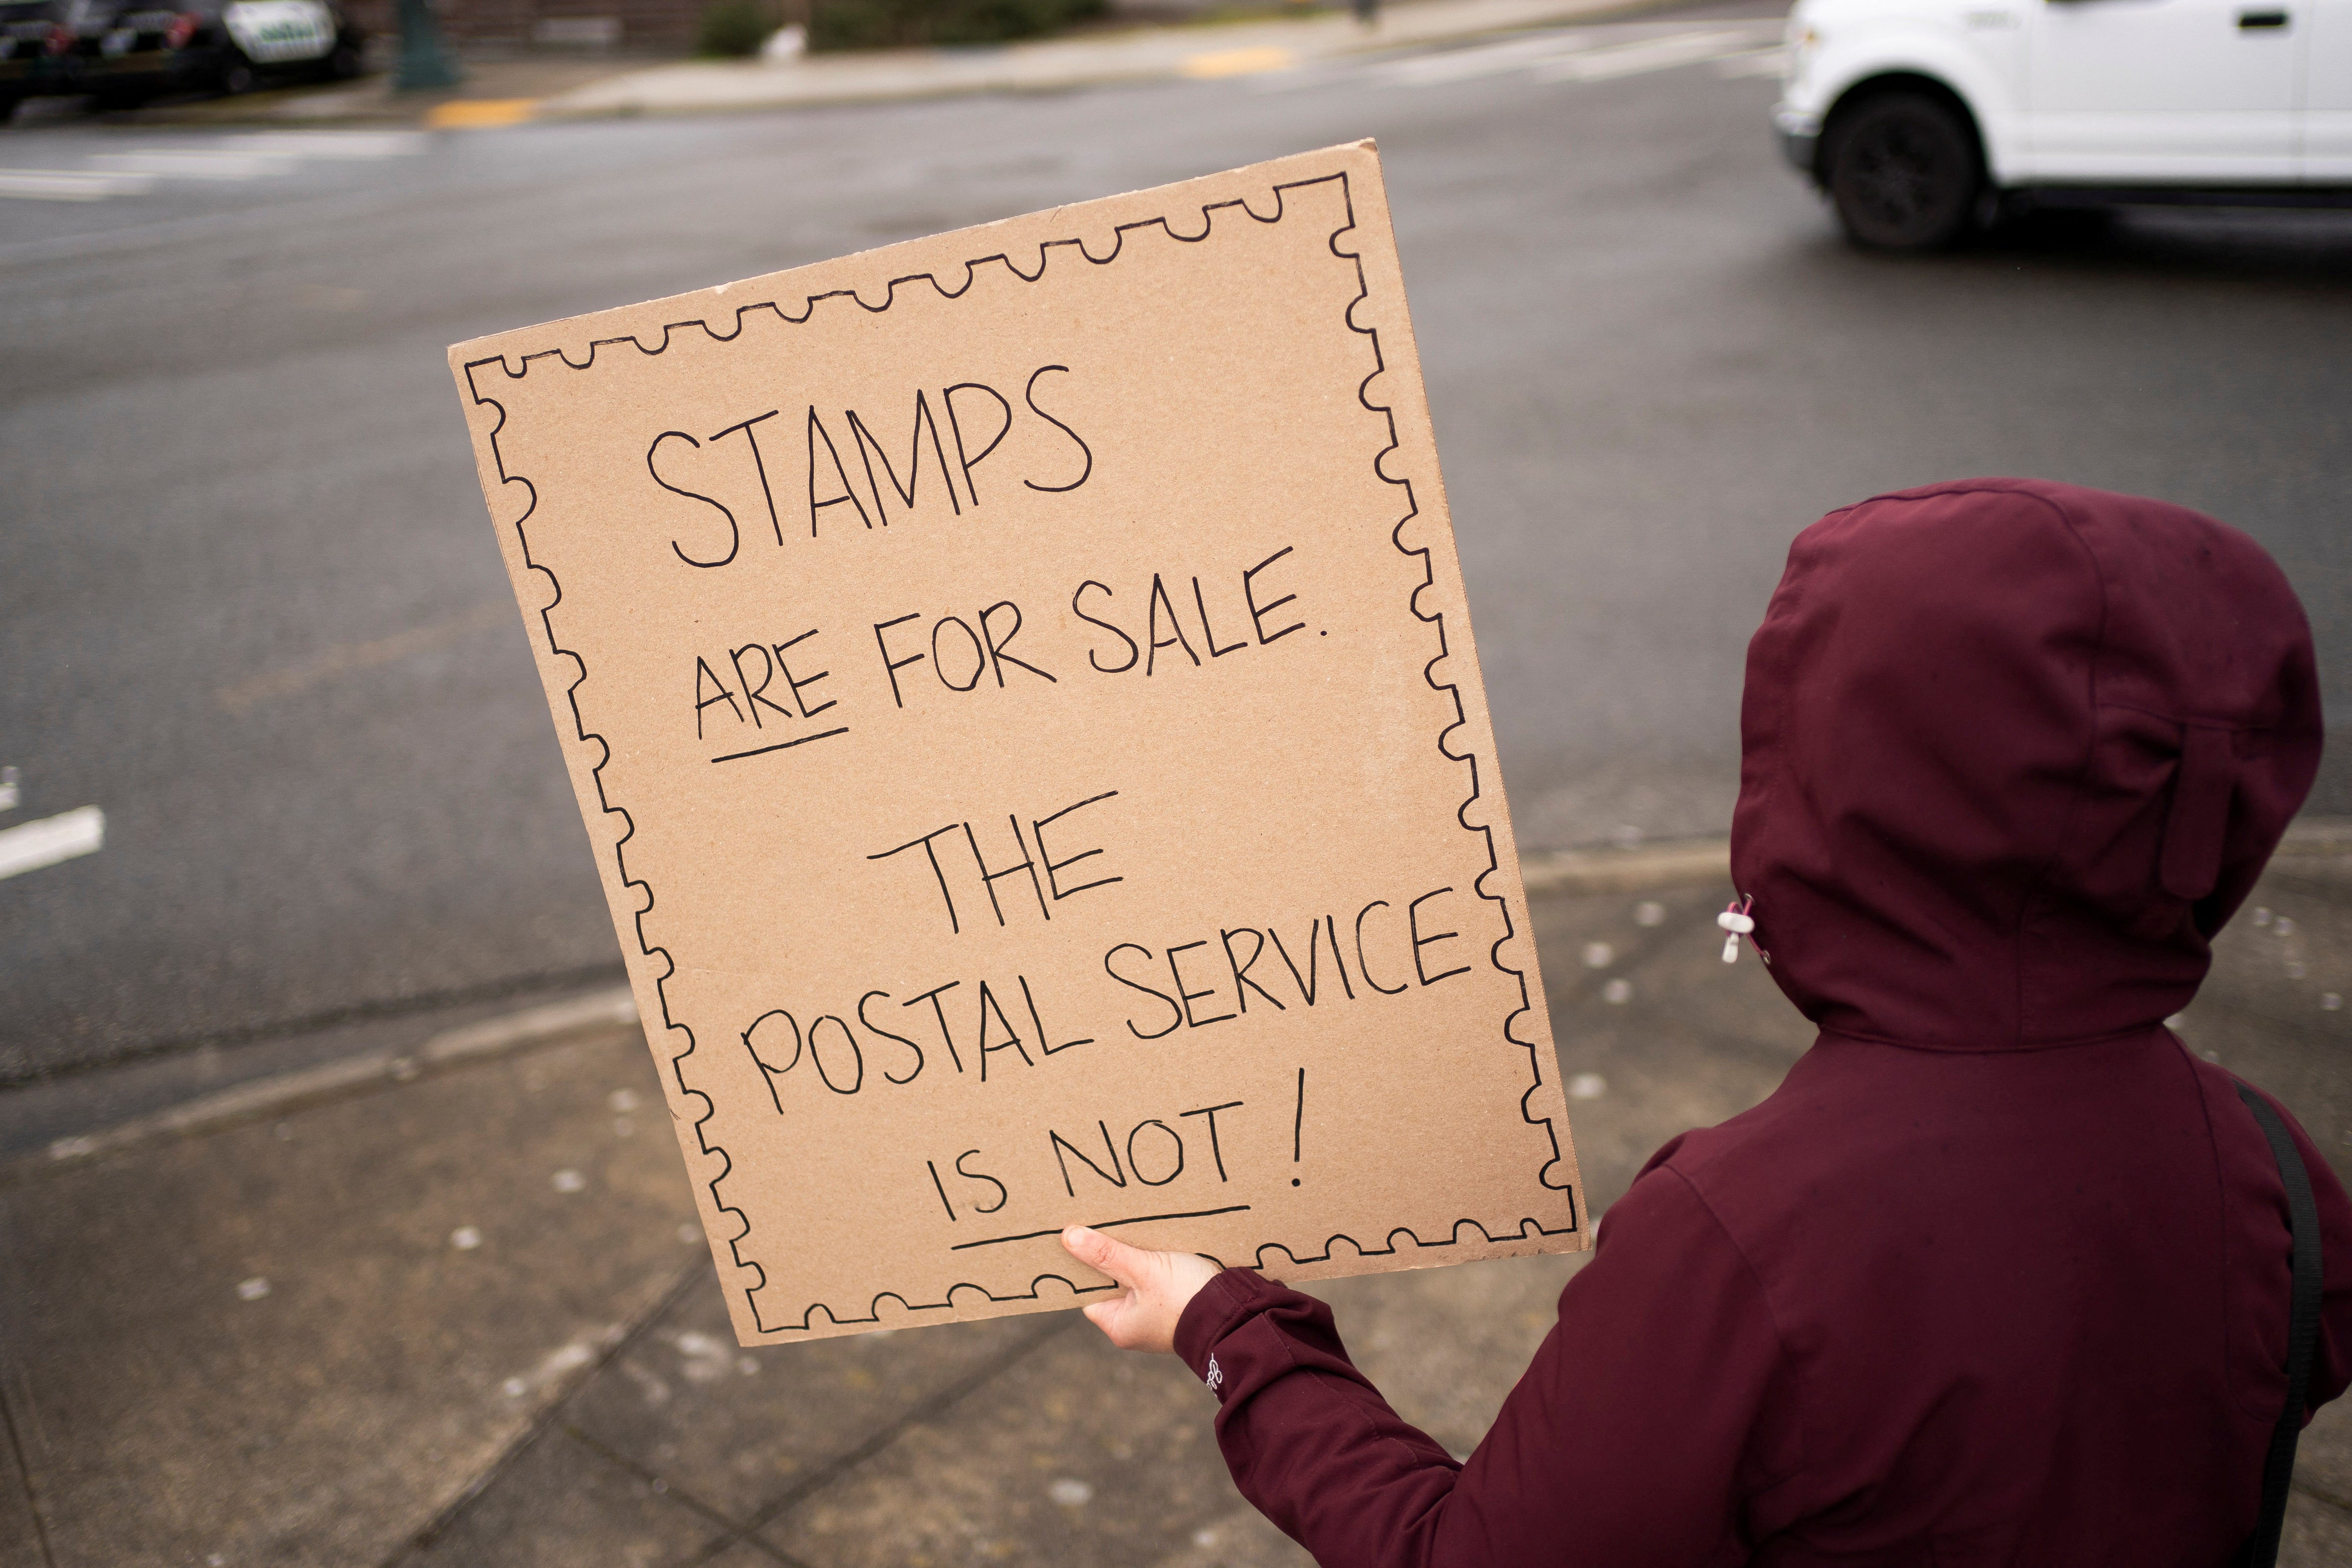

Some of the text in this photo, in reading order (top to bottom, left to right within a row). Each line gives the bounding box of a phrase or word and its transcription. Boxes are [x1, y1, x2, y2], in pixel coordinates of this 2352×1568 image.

[646, 364, 1093, 569] STAMPS
[694, 545, 1328, 741] ARE FOR SALE.
[866, 789, 1124, 935] THE
[740, 886, 1472, 1116] POSTAL SERVICE
[926, 1149, 1008, 1222] IS
